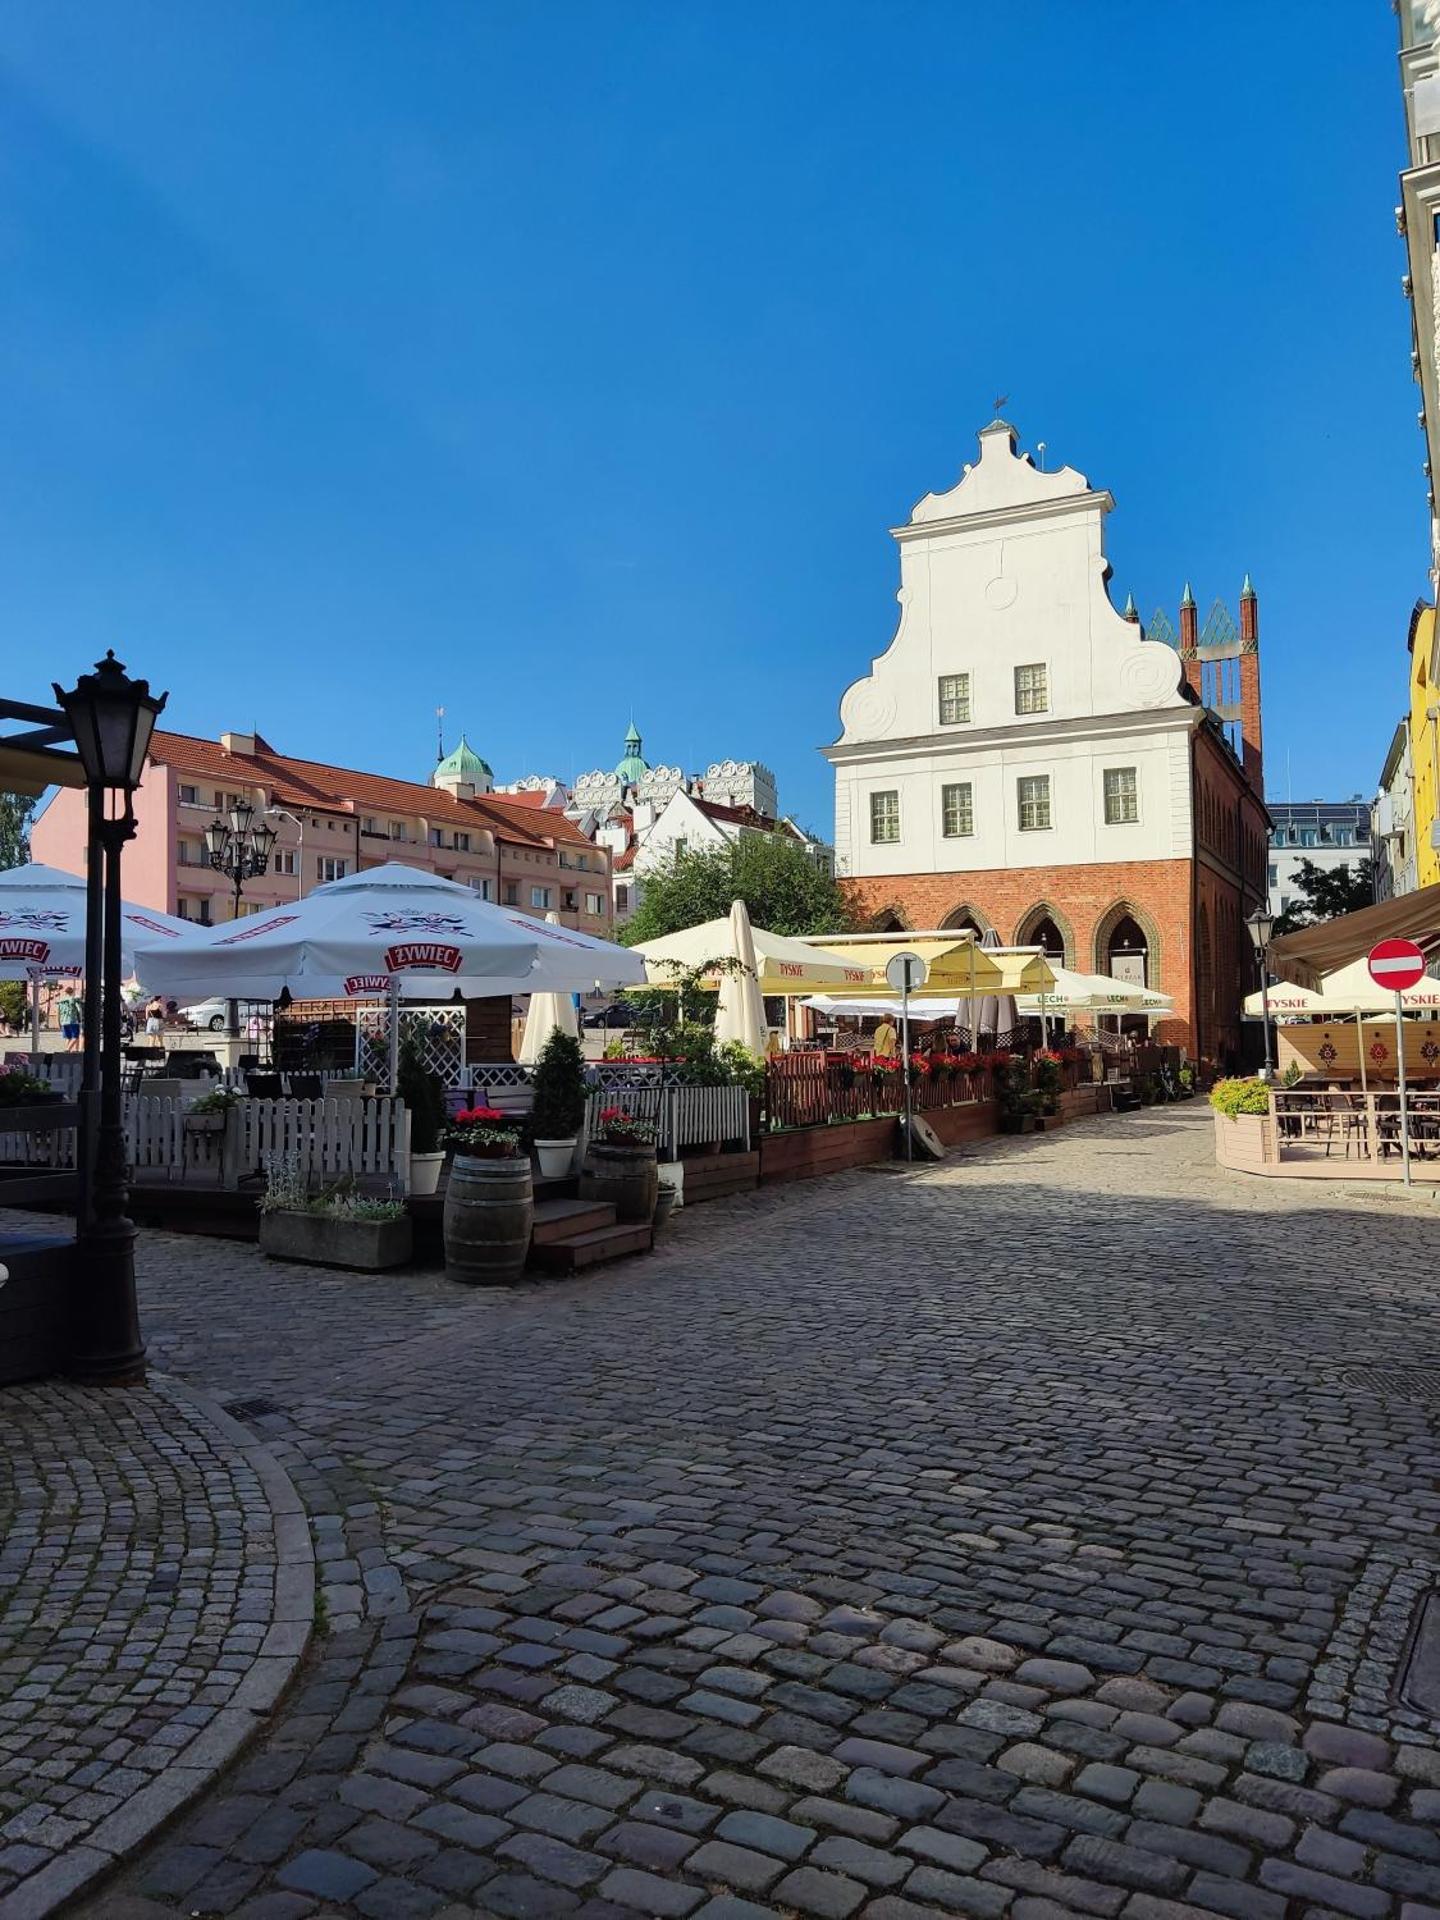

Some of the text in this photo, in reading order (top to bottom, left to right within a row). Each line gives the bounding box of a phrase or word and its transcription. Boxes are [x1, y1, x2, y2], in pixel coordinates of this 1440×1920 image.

[0, 940, 42, 956] YWIEC
[395, 945, 454, 963] ŻYWIEC
[779, 962, 804, 977] TYSKIE
[1037, 995, 1063, 1003] LECH
[1265, 999, 1309, 1008] TYSKIE
[1393, 994, 1440, 1005] YSKIE
